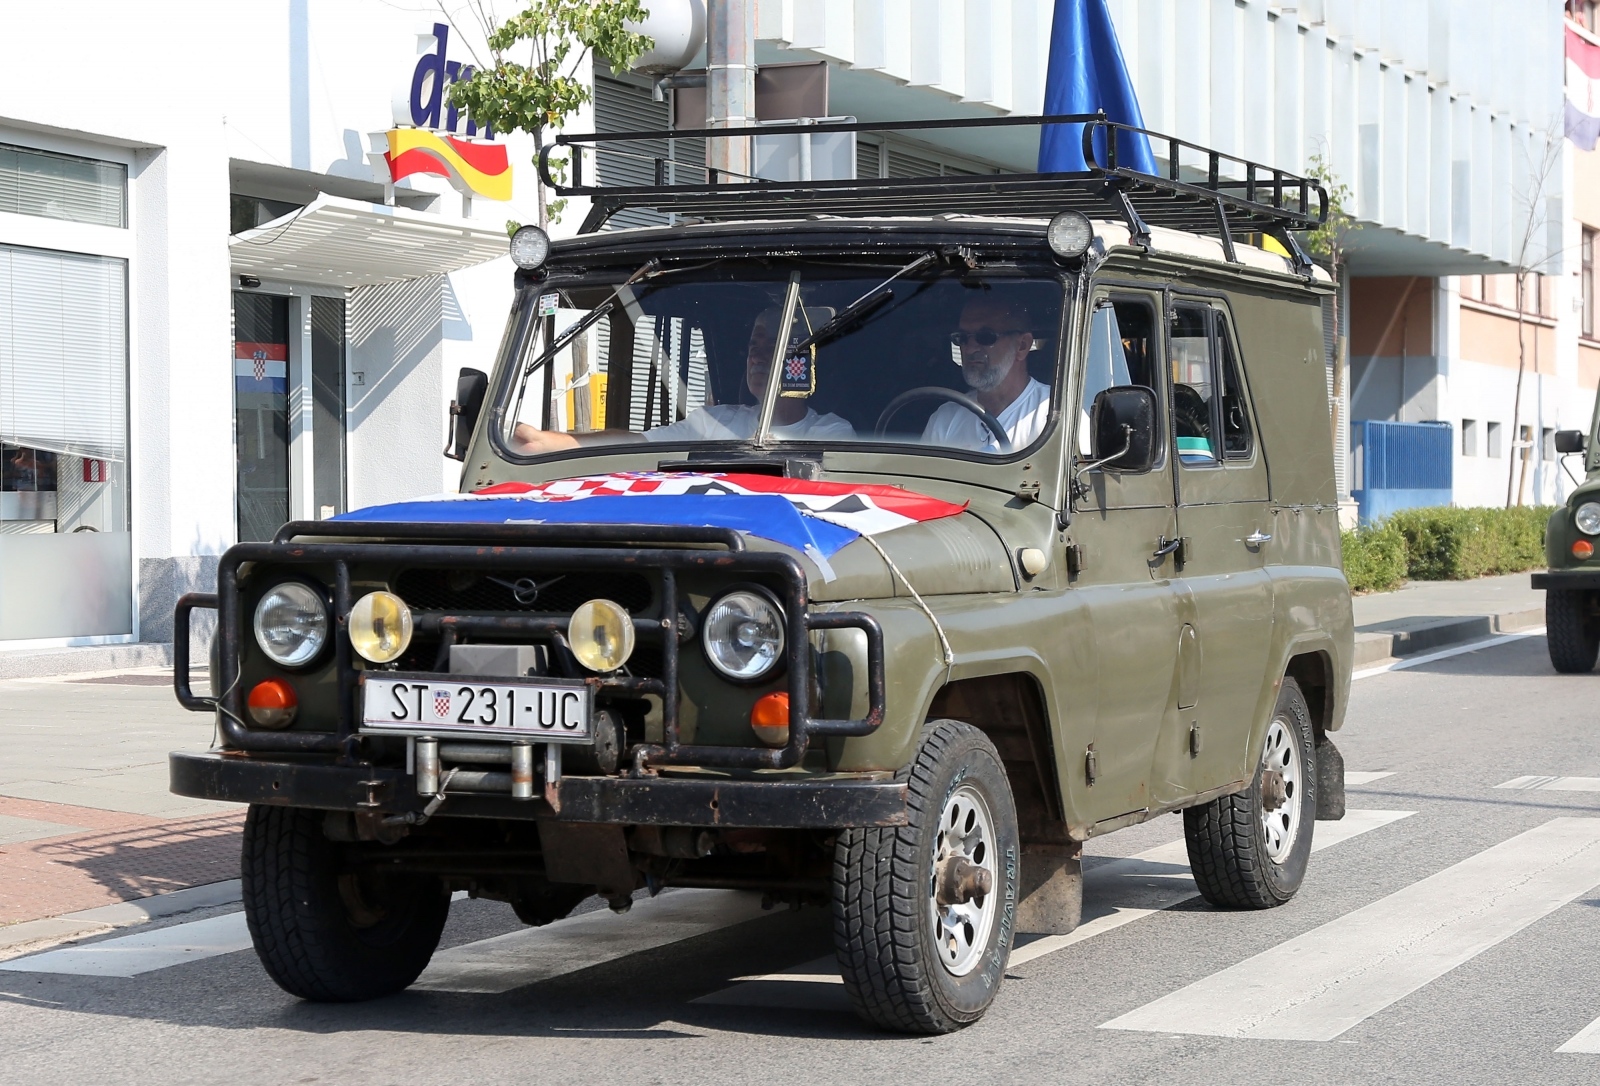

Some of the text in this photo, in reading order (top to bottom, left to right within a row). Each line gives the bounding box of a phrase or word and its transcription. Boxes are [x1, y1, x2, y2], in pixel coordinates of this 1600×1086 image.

[391, 683, 580, 730] ST 231-UC
[998, 848, 1016, 947] TRAVIA
